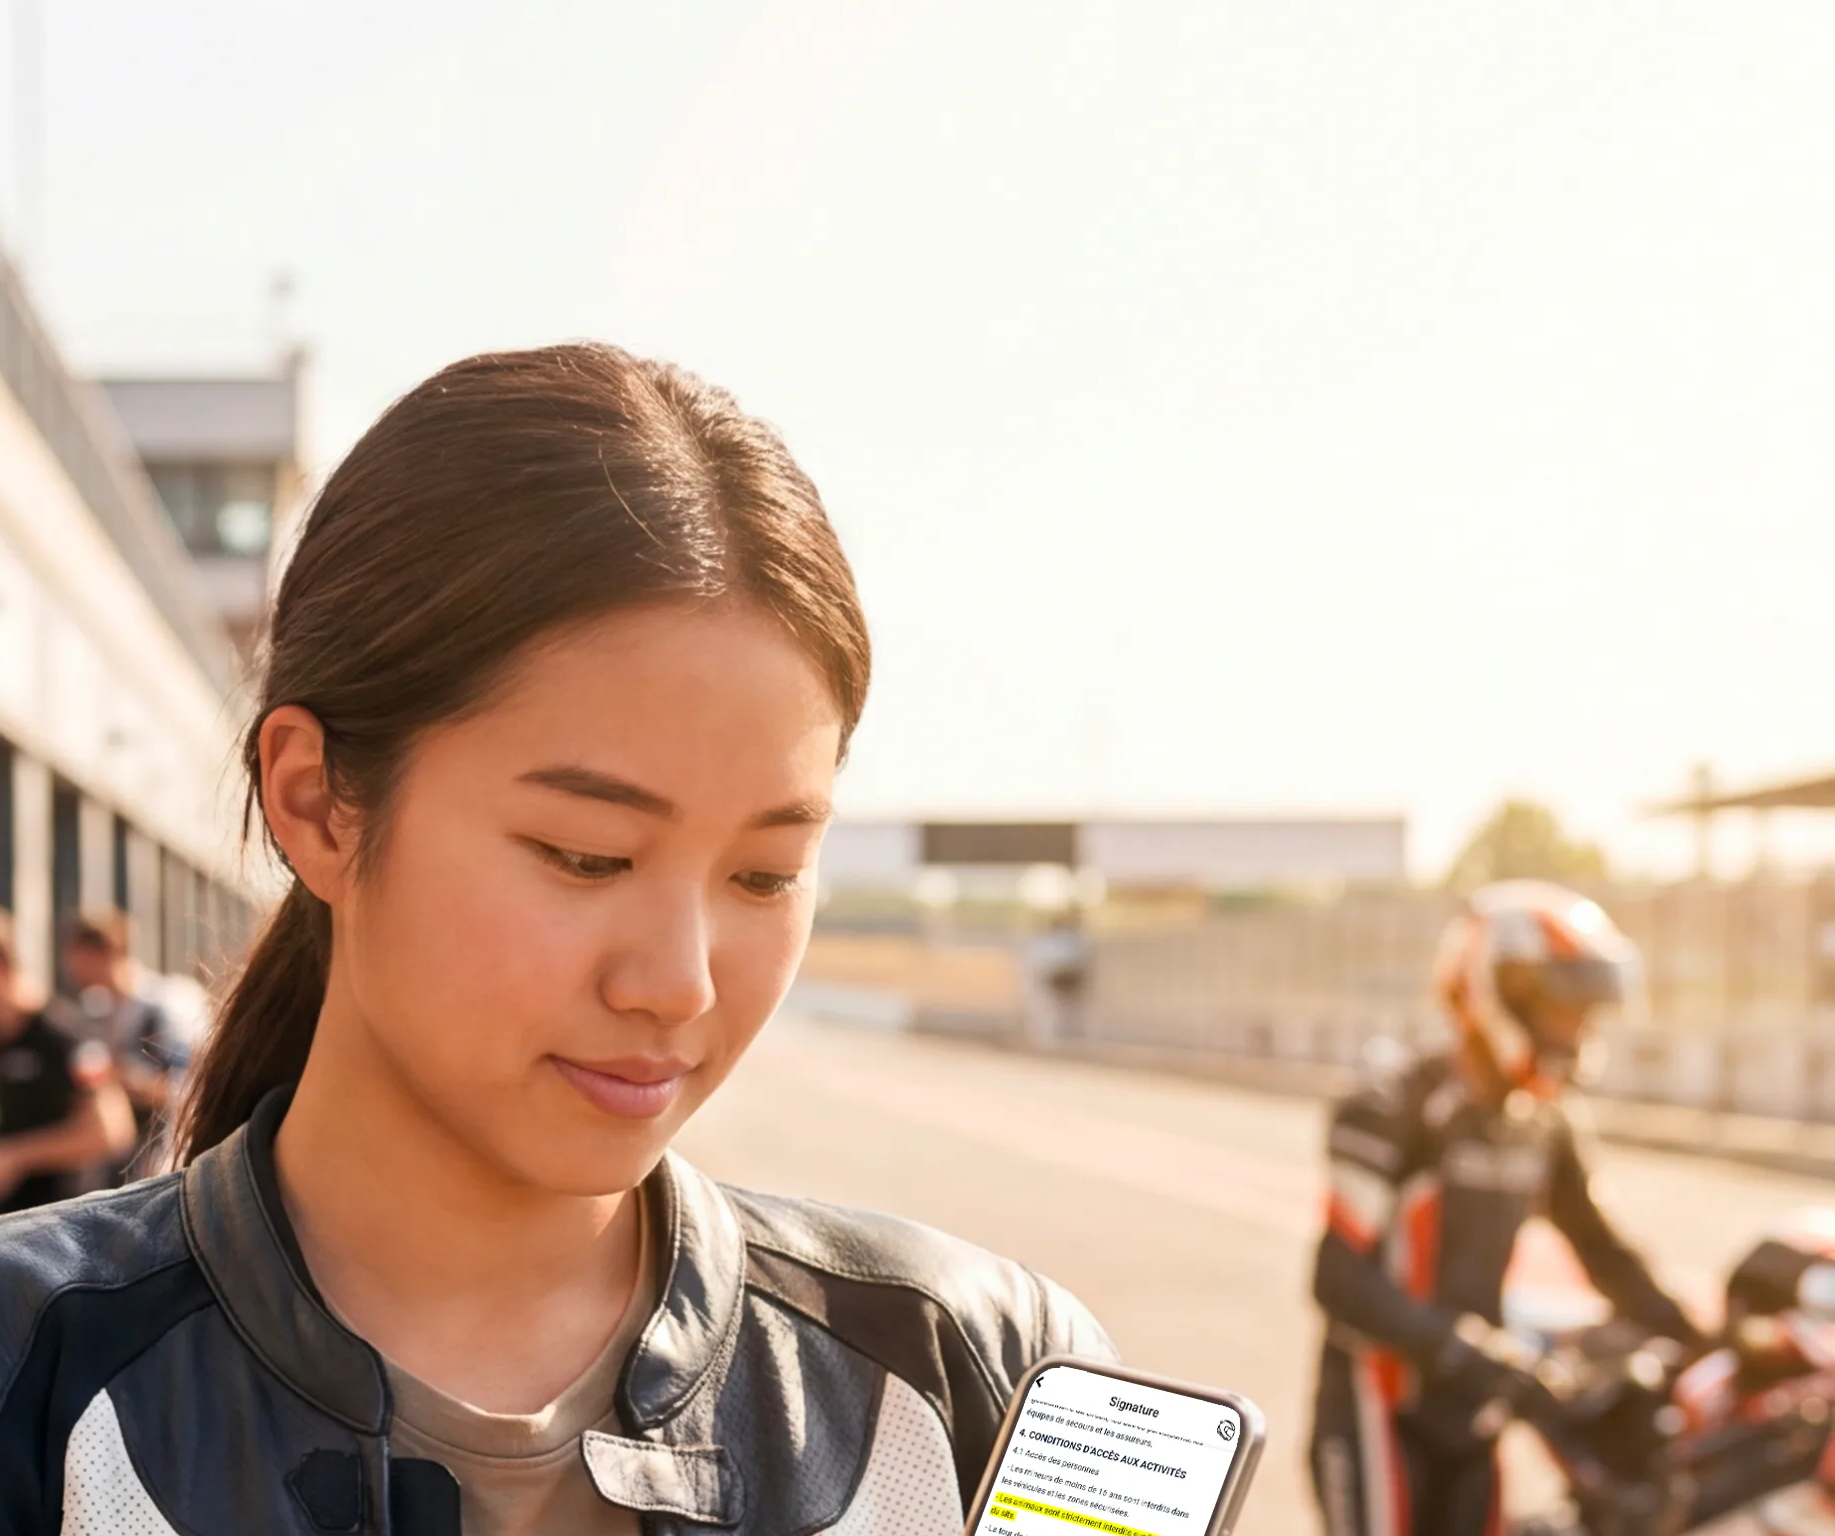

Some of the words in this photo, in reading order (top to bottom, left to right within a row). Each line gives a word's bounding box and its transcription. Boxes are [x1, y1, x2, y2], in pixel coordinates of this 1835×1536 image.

[1109, 1396, 1159, 1418] Signature
[1026, 1409, 1054, 1422] équipes
[1055, 1416, 1065, 1424] de
[1065, 1419, 1094, 1432] secours
[1103, 1428, 1115, 1437] les
[1115, 1433, 1152, 1447] assureurs.
[1019, 1428, 1026, 1437] 4.
[1029, 1431, 1082, 1451] CONDITIONS
[1083, 1445, 1120, 1461] D'ACCÈS
[1120, 1455, 1140, 1467] AUX
[1140, 1461, 1187, 1479] ACTIVITÉS
[1025, 1450, 1047, 1461] Accès
[1047, 1456, 1061, 1465] des
[1061, 1461, 1099, 1475] personnes
[1001, 1476, 1013, 1485] les
[1055, 1491, 1066, 1500] les
[1067, 1495, 1089, 1506] zones
[1010, 1464, 1024, 1474] Les
[1053, 1476, 1064, 1484] de
[1064, 1480, 1086, 1491] moins
[1087, 1486, 1097, 1494] de
[1109, 1492, 1122, 1500] ans
[1171, 1508, 1189, 1518] dans
[990, 1507, 1000, 1515] du
[999, 1494, 1013, 1504] Les
[1044, 1508, 1061, 1517] sont
[1061, 1512, 1102, 1528] strictement
[1103, 1523, 1132, 1536] interdits
[998, 1527, 1013, 1536] tour
